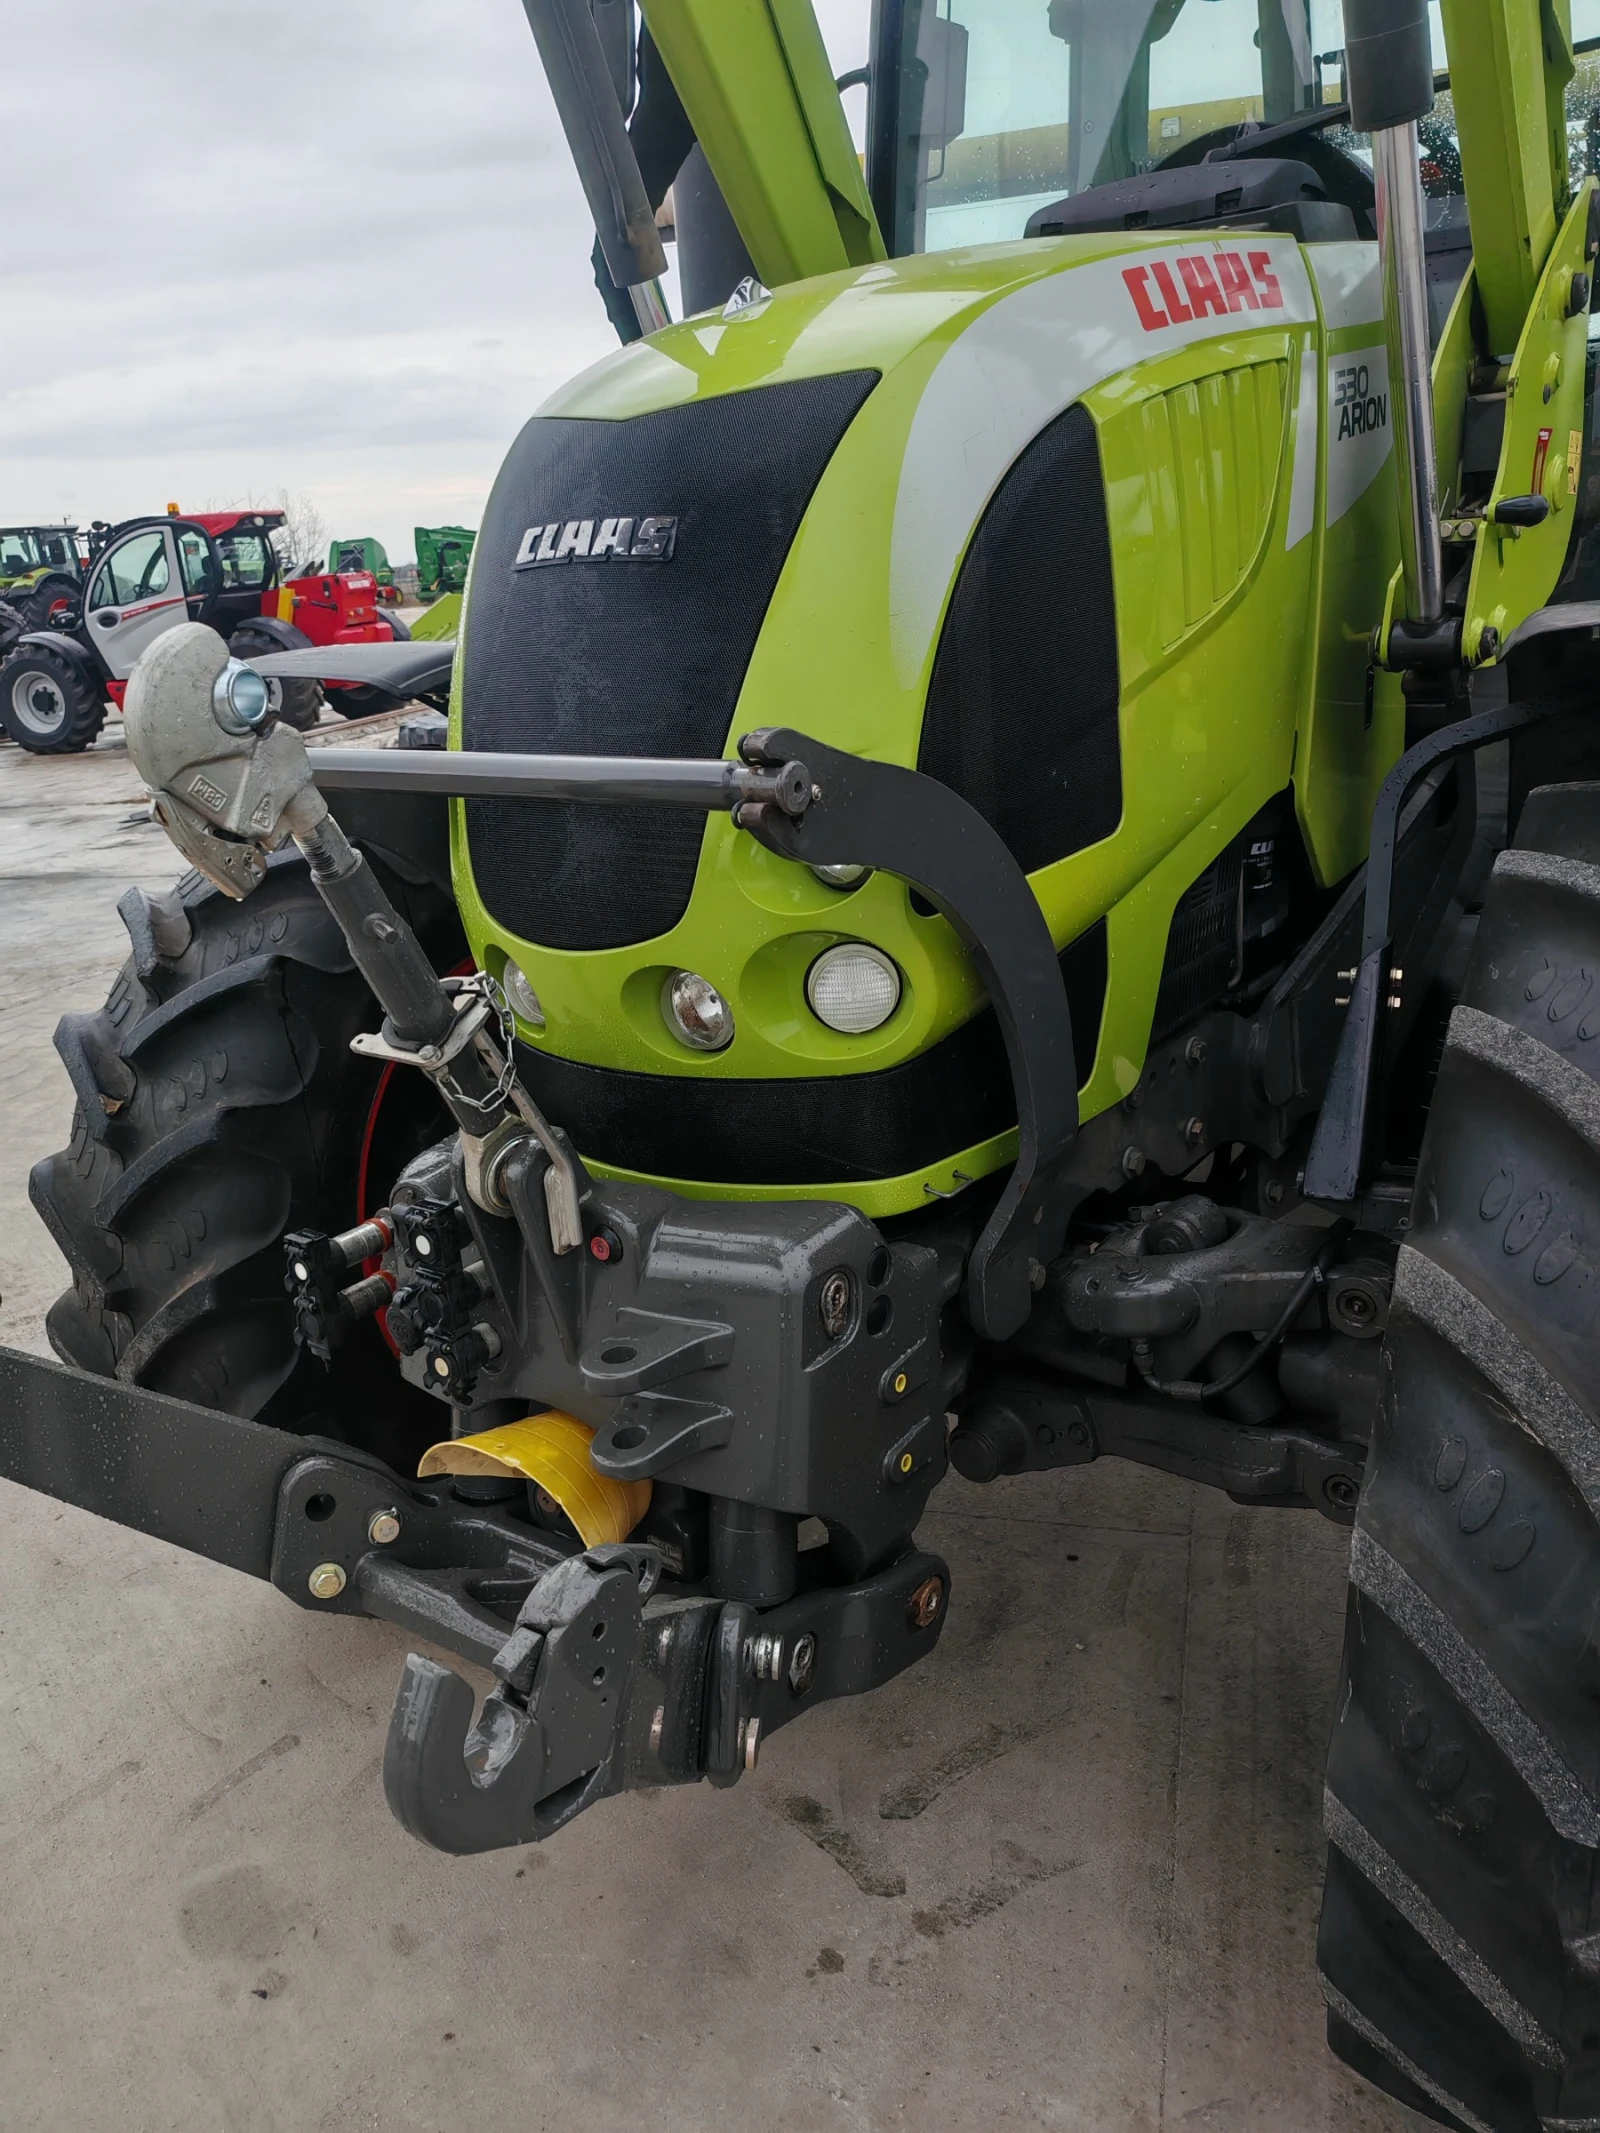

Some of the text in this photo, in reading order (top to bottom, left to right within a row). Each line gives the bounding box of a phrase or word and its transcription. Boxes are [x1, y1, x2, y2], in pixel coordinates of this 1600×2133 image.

[1121, 251, 1284, 332] CLAAS
[1333, 364, 1369, 407] 530
[1337, 393, 1387, 442] ARION
[514, 516, 674, 565] CLAAS
